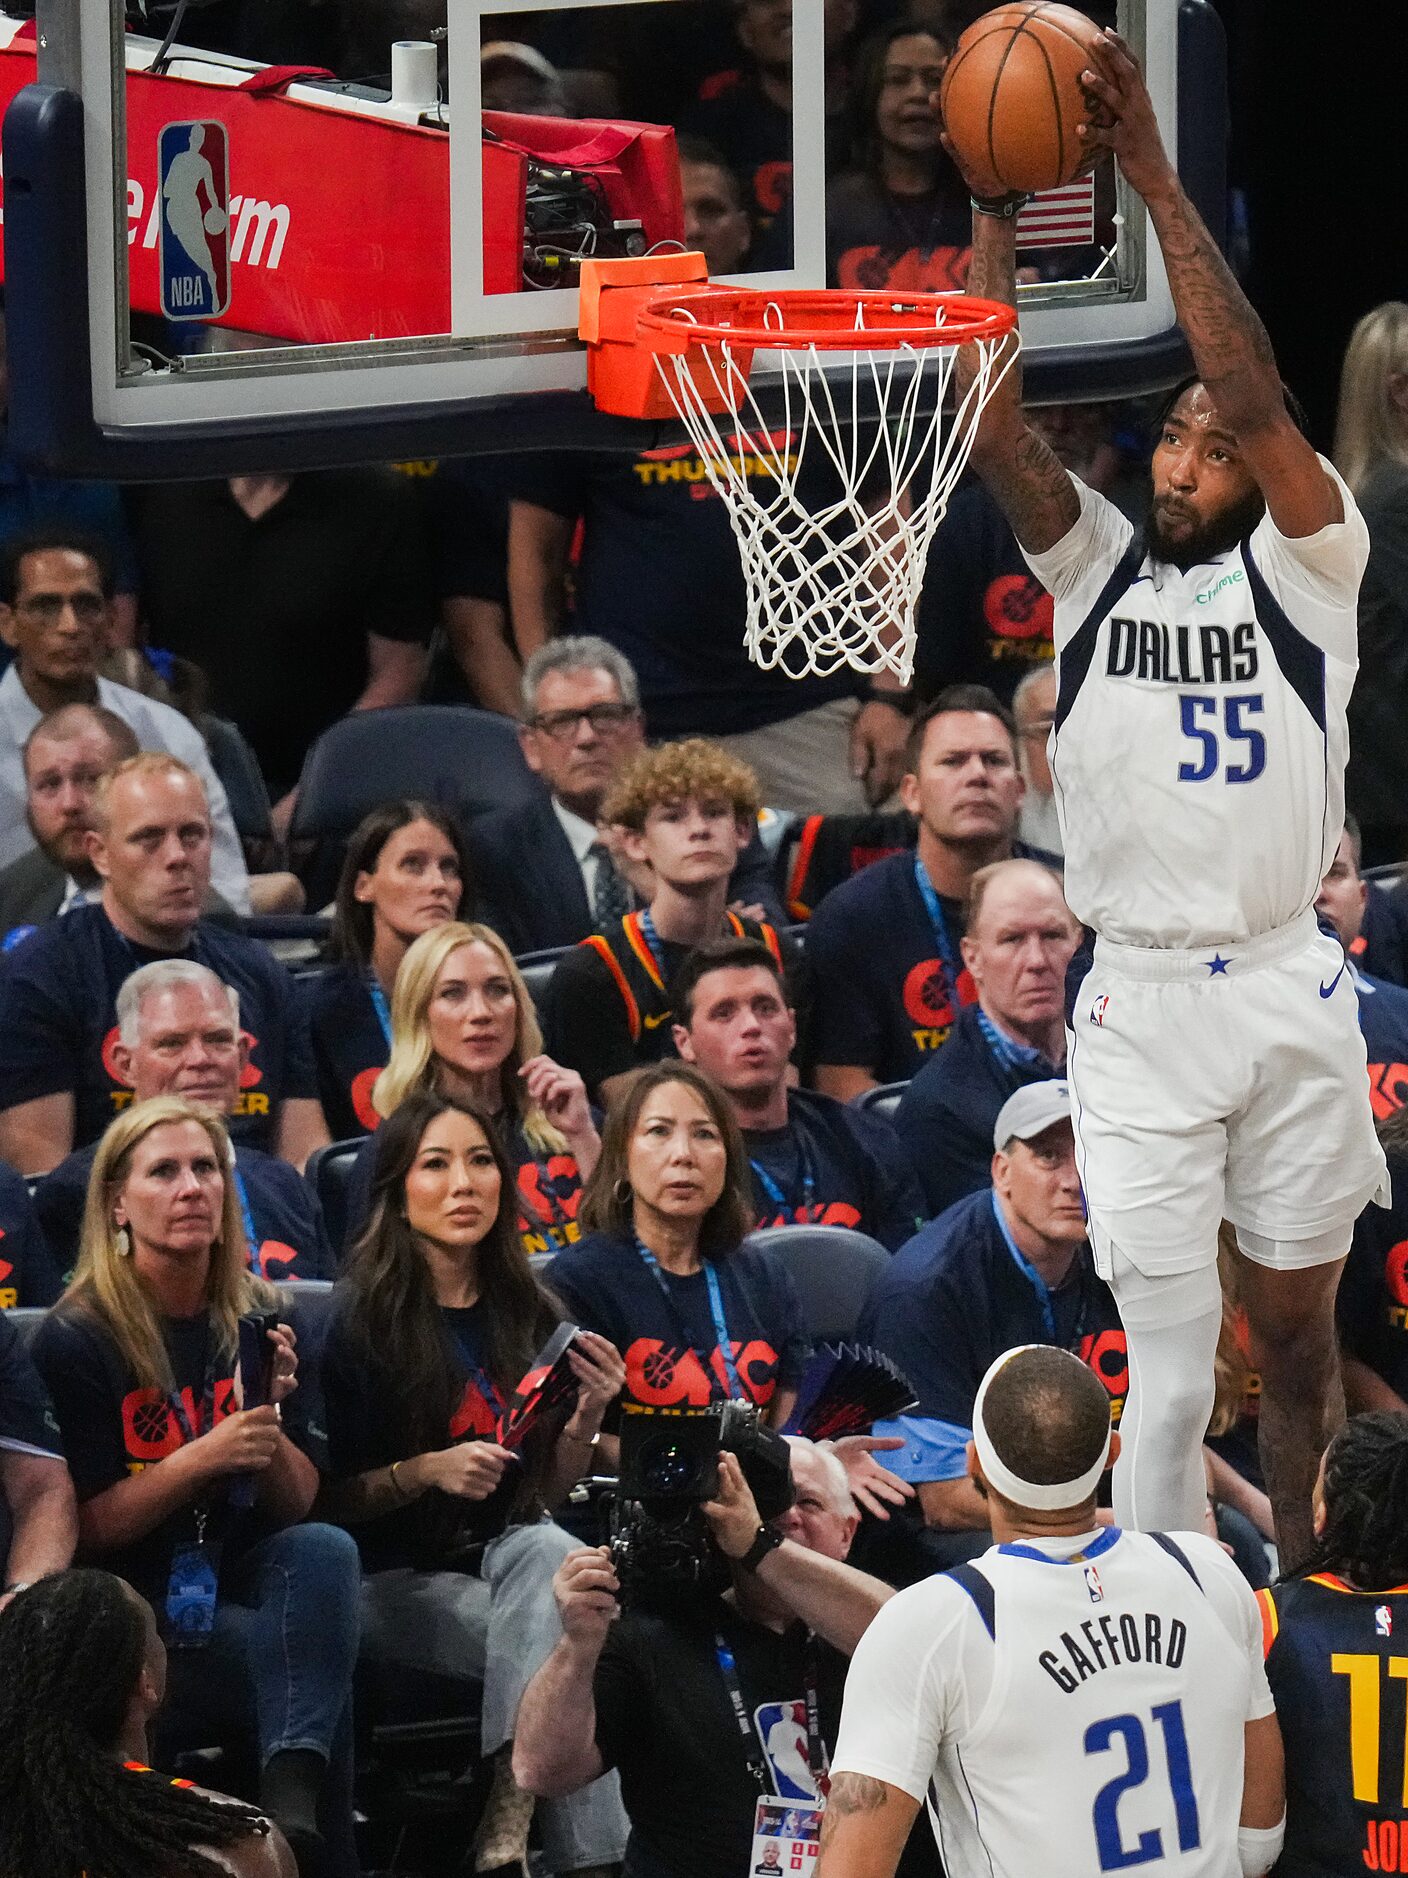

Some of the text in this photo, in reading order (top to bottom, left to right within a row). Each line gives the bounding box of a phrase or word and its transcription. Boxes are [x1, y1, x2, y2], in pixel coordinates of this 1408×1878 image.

[171, 275, 204, 307] NBA
[1196, 568, 1245, 605] chime
[1105, 616, 1259, 685] DALLAS
[1177, 693, 1267, 785] 55
[624, 1337, 779, 1406] OKC
[1038, 1613, 1187, 1694] GAFFORD
[1083, 1699, 1202, 1873] 21
